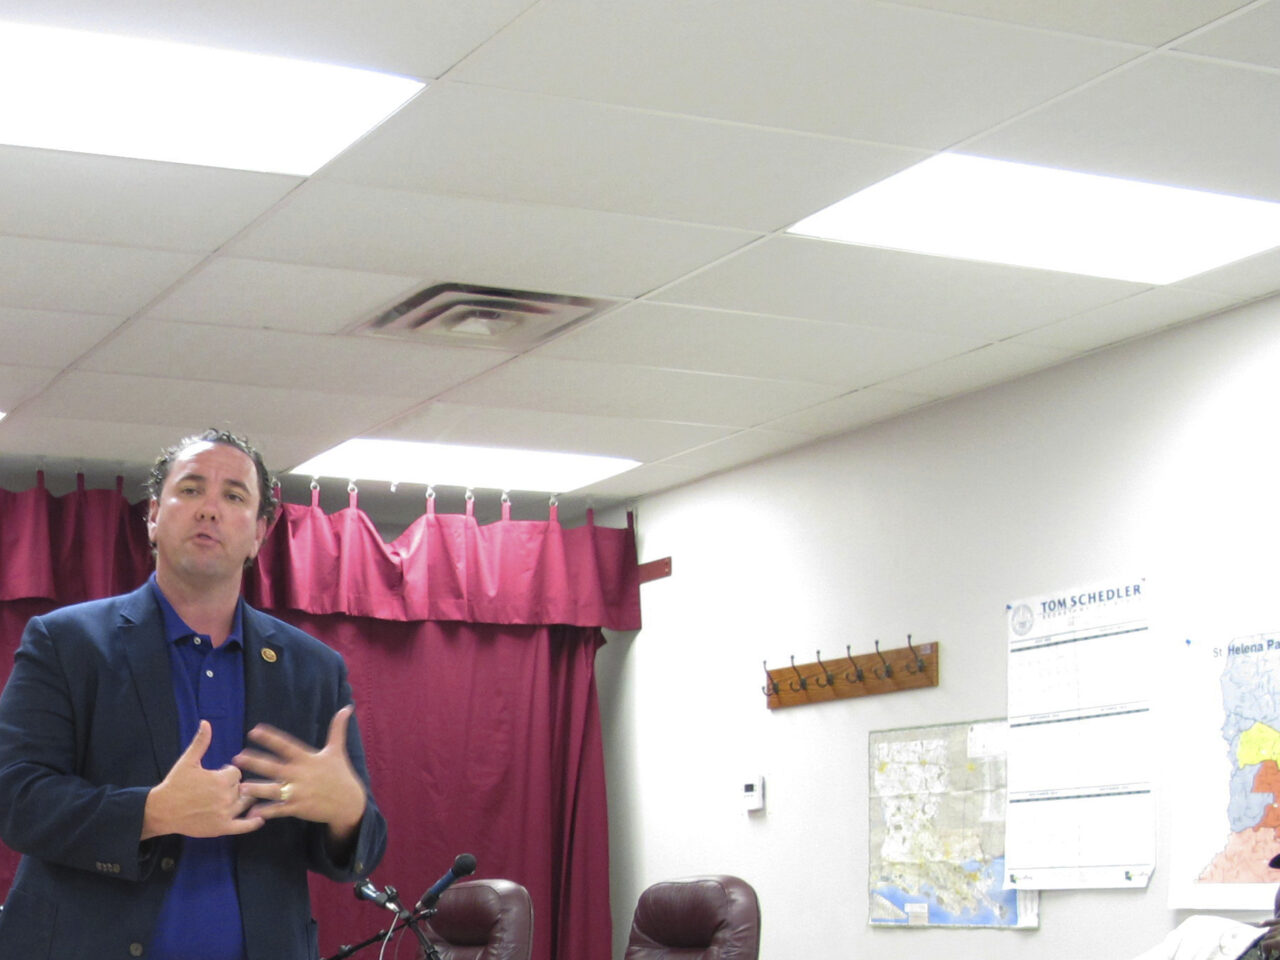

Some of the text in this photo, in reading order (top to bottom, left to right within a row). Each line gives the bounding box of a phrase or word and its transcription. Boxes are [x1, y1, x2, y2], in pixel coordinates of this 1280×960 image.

[1041, 598, 1067, 613] TOM
[1070, 584, 1141, 607] SCHEDLER
[1228, 643, 1263, 656] Helena
